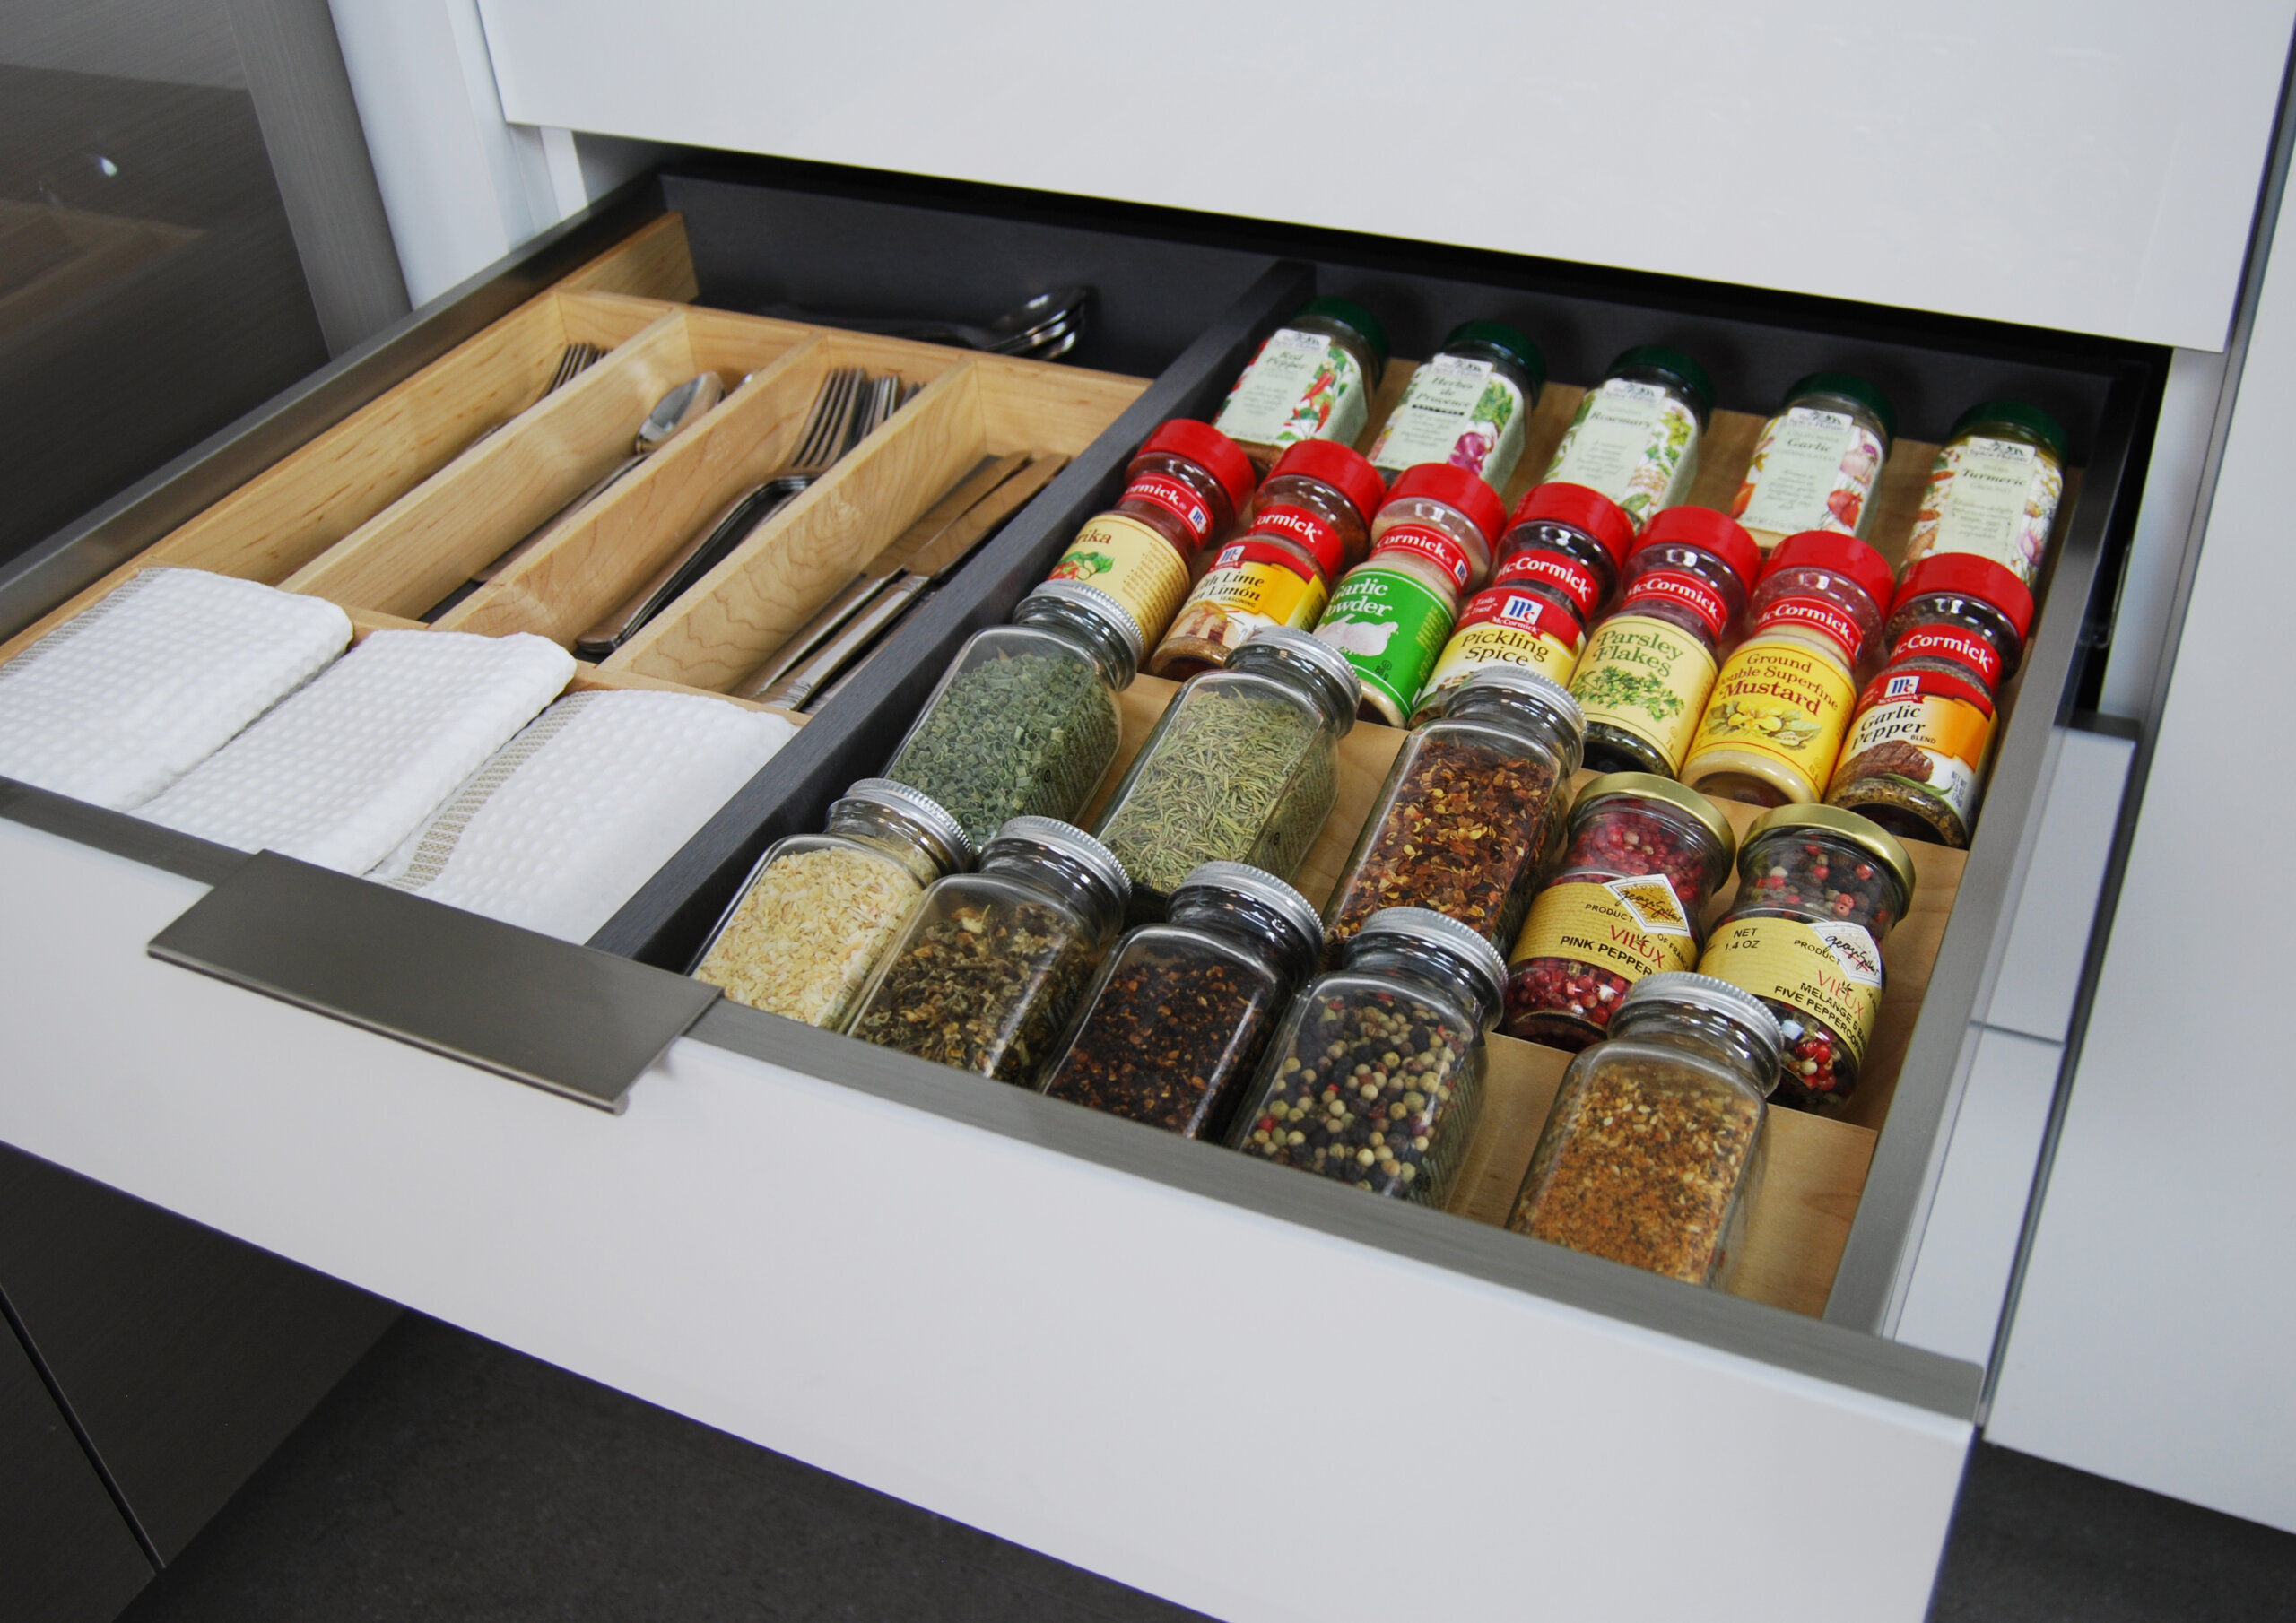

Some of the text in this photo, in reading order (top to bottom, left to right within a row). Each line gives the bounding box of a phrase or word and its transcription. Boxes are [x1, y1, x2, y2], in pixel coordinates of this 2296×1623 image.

[1265, 356, 1308, 370] Pepper
[1279, 350, 1305, 361] Red
[1431, 376, 1474, 389] Herbes
[1415, 393, 1472, 408] Provence
[1590, 412, 1653, 429] Rosemary
[1787, 438, 1832, 452] Garlic
[1962, 468, 2025, 486] Turmeric
[1125, 483, 1180, 507] ormick
[1072, 529, 1112, 545] rika
[1256, 514, 1316, 543] ormick
[1377, 534, 1447, 560] Cormick
[1222, 570, 1265, 588] Lime
[1208, 584, 1262, 602] Limón
[1220, 595, 1257, 609] SEASONING
[1326, 595, 1394, 617] owder
[1491, 615, 1538, 635] McCormick
[1460, 629, 1550, 663] Pickling
[1596, 629, 1685, 661] Parsley
[1465, 646, 1529, 667] Spice
[1592, 644, 1673, 678] Flakes
[1746, 653, 1813, 673] Ground
[1718, 680, 1822, 716] Mustard
[1762, 665, 1839, 711] Superfine
[1860, 704, 1921, 732] Garlic
[1851, 722, 1926, 751] Pepper
[1909, 733, 1937, 745] BLEND
[1584, 903, 1635, 924] PRODUCT
[1657, 933, 1669, 944] OF
[1733, 927, 1759, 939] NET
[1610, 924, 1666, 969] VILUX
[1724, 940, 1740, 951] 1.4
[1742, 939, 1761, 950] OZ
[1793, 939, 1841, 966] PRODUCT
[1559, 935, 1654, 976] PINK PEPPER
[1774, 985, 1804, 1003] FIVE
[1800, 982, 1853, 1024] MELANGE
